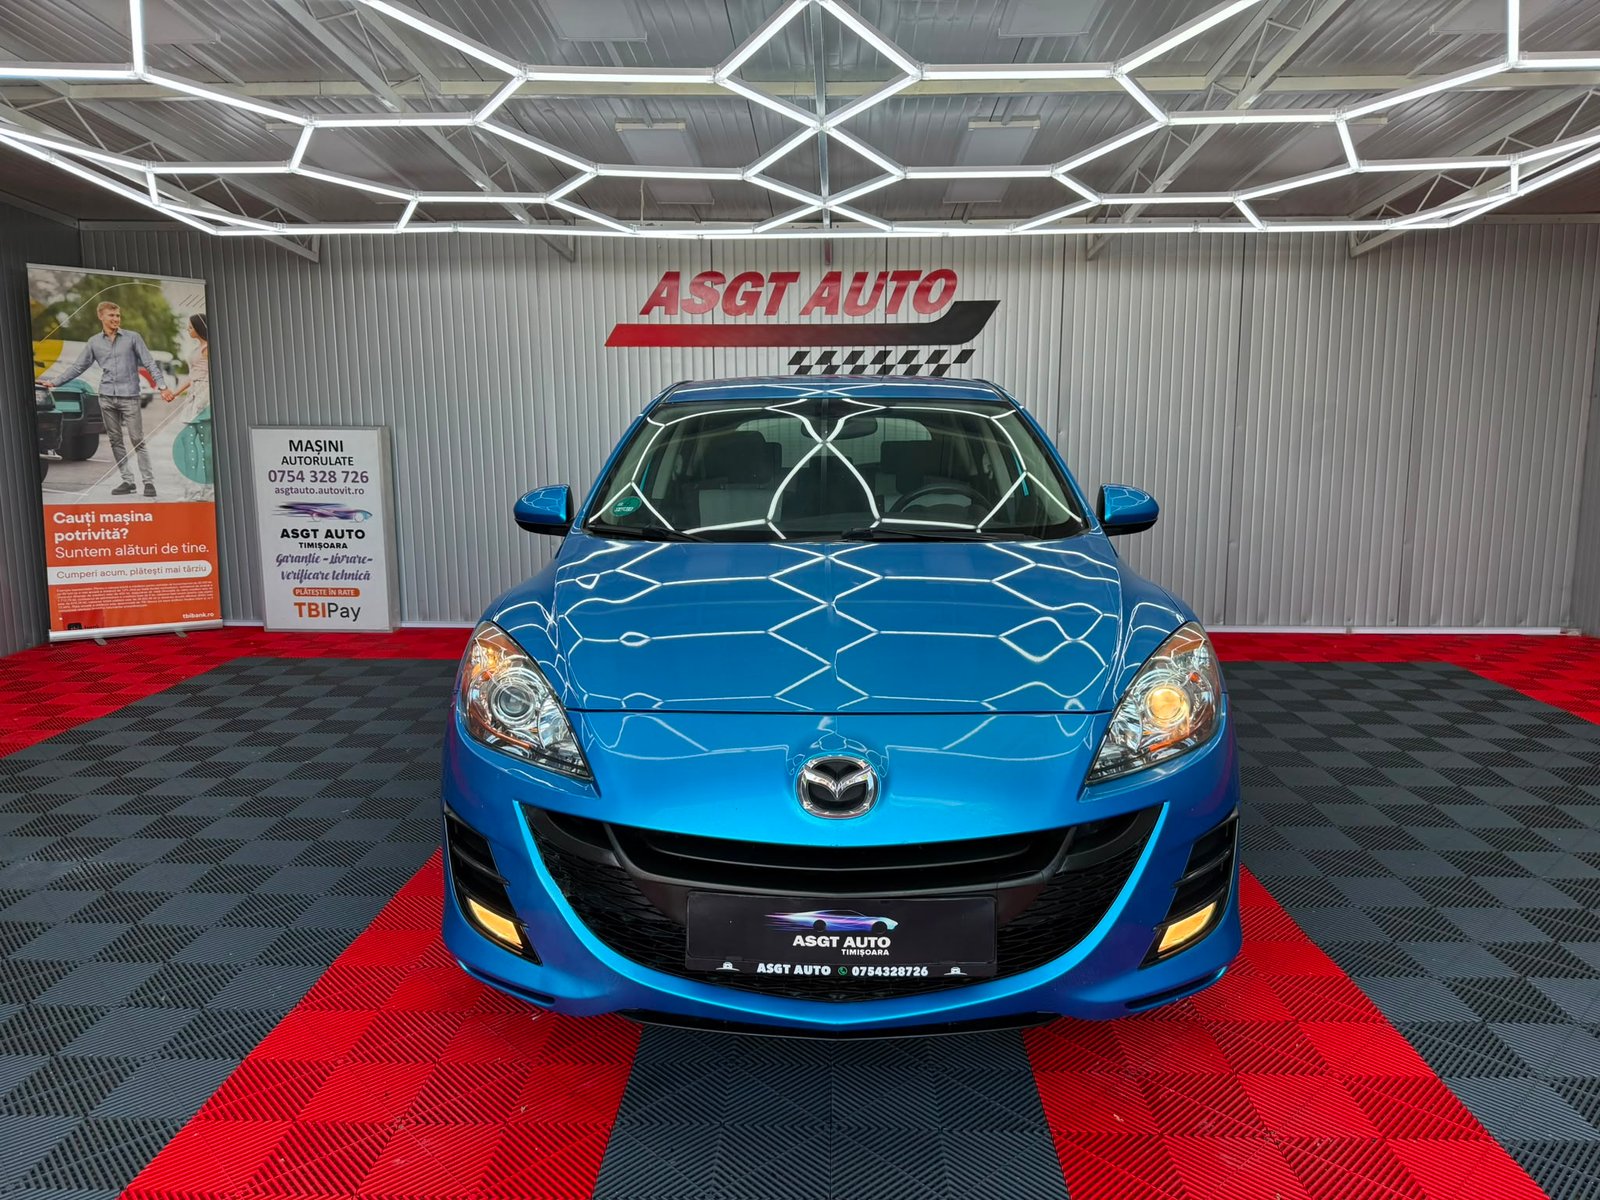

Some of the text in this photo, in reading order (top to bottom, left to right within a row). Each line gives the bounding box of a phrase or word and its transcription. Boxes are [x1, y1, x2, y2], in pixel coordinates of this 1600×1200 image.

[639, 268, 958, 316] ASGT AUTO
[288, 439, 344, 455] MAȘINI
[281, 455, 354, 466] AUTORULATE
[268, 469, 369, 483] 0754 328 726
[274, 486, 365, 496] asgtauto.autovit.ro
[53, 510, 153, 527] Cauți mașina
[54, 527, 129, 544] potrivită?
[280, 528, 366, 540] ASGT AUTO
[55, 542, 209, 559] Suntem alături de tine.
[298, 542, 348, 551] TIMIȘOARA
[56, 569, 98, 580] Cumperi
[100, 569, 128, 578] acum,
[165, 565, 181, 574] mai
[182, 563, 207, 573] târziu
[331, 569, 371, 581] tehnică
[328, 587, 337, 596] ÎN
[337, 588, 355, 596] RATE
[182, 611, 215, 619] tbibank.ro
[293, 602, 361, 622] TBIPay
[792, 935, 891, 948] ASGT AUTO
[841, 948, 890, 958] TIMIȘOARA
[756, 962, 929, 977] ASGT AUTO 0754328726
